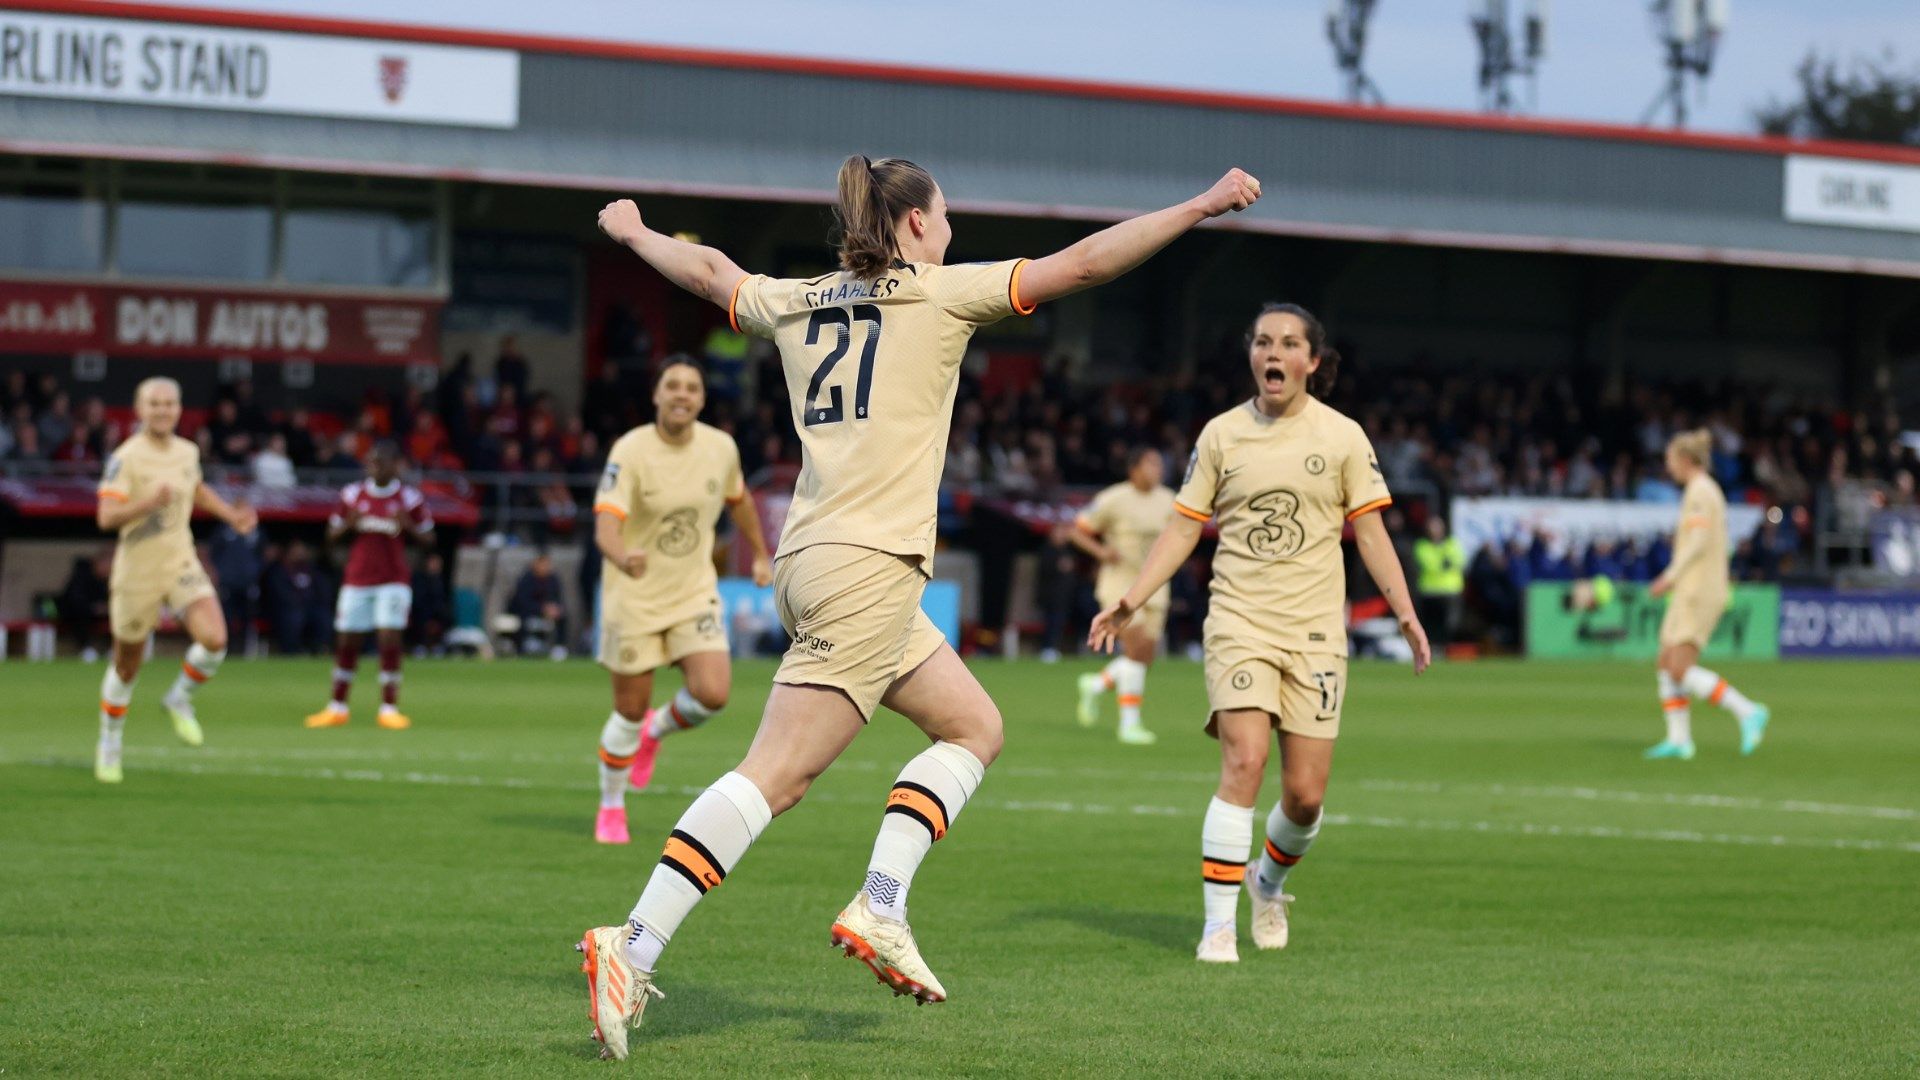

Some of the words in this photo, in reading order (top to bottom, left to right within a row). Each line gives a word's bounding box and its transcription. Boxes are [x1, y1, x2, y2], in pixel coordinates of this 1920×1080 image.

[140, 36, 269, 99] STAND
[116, 296, 198, 346] DON
[207, 301, 329, 351] AUTOS
[803, 303, 883, 427] 27
